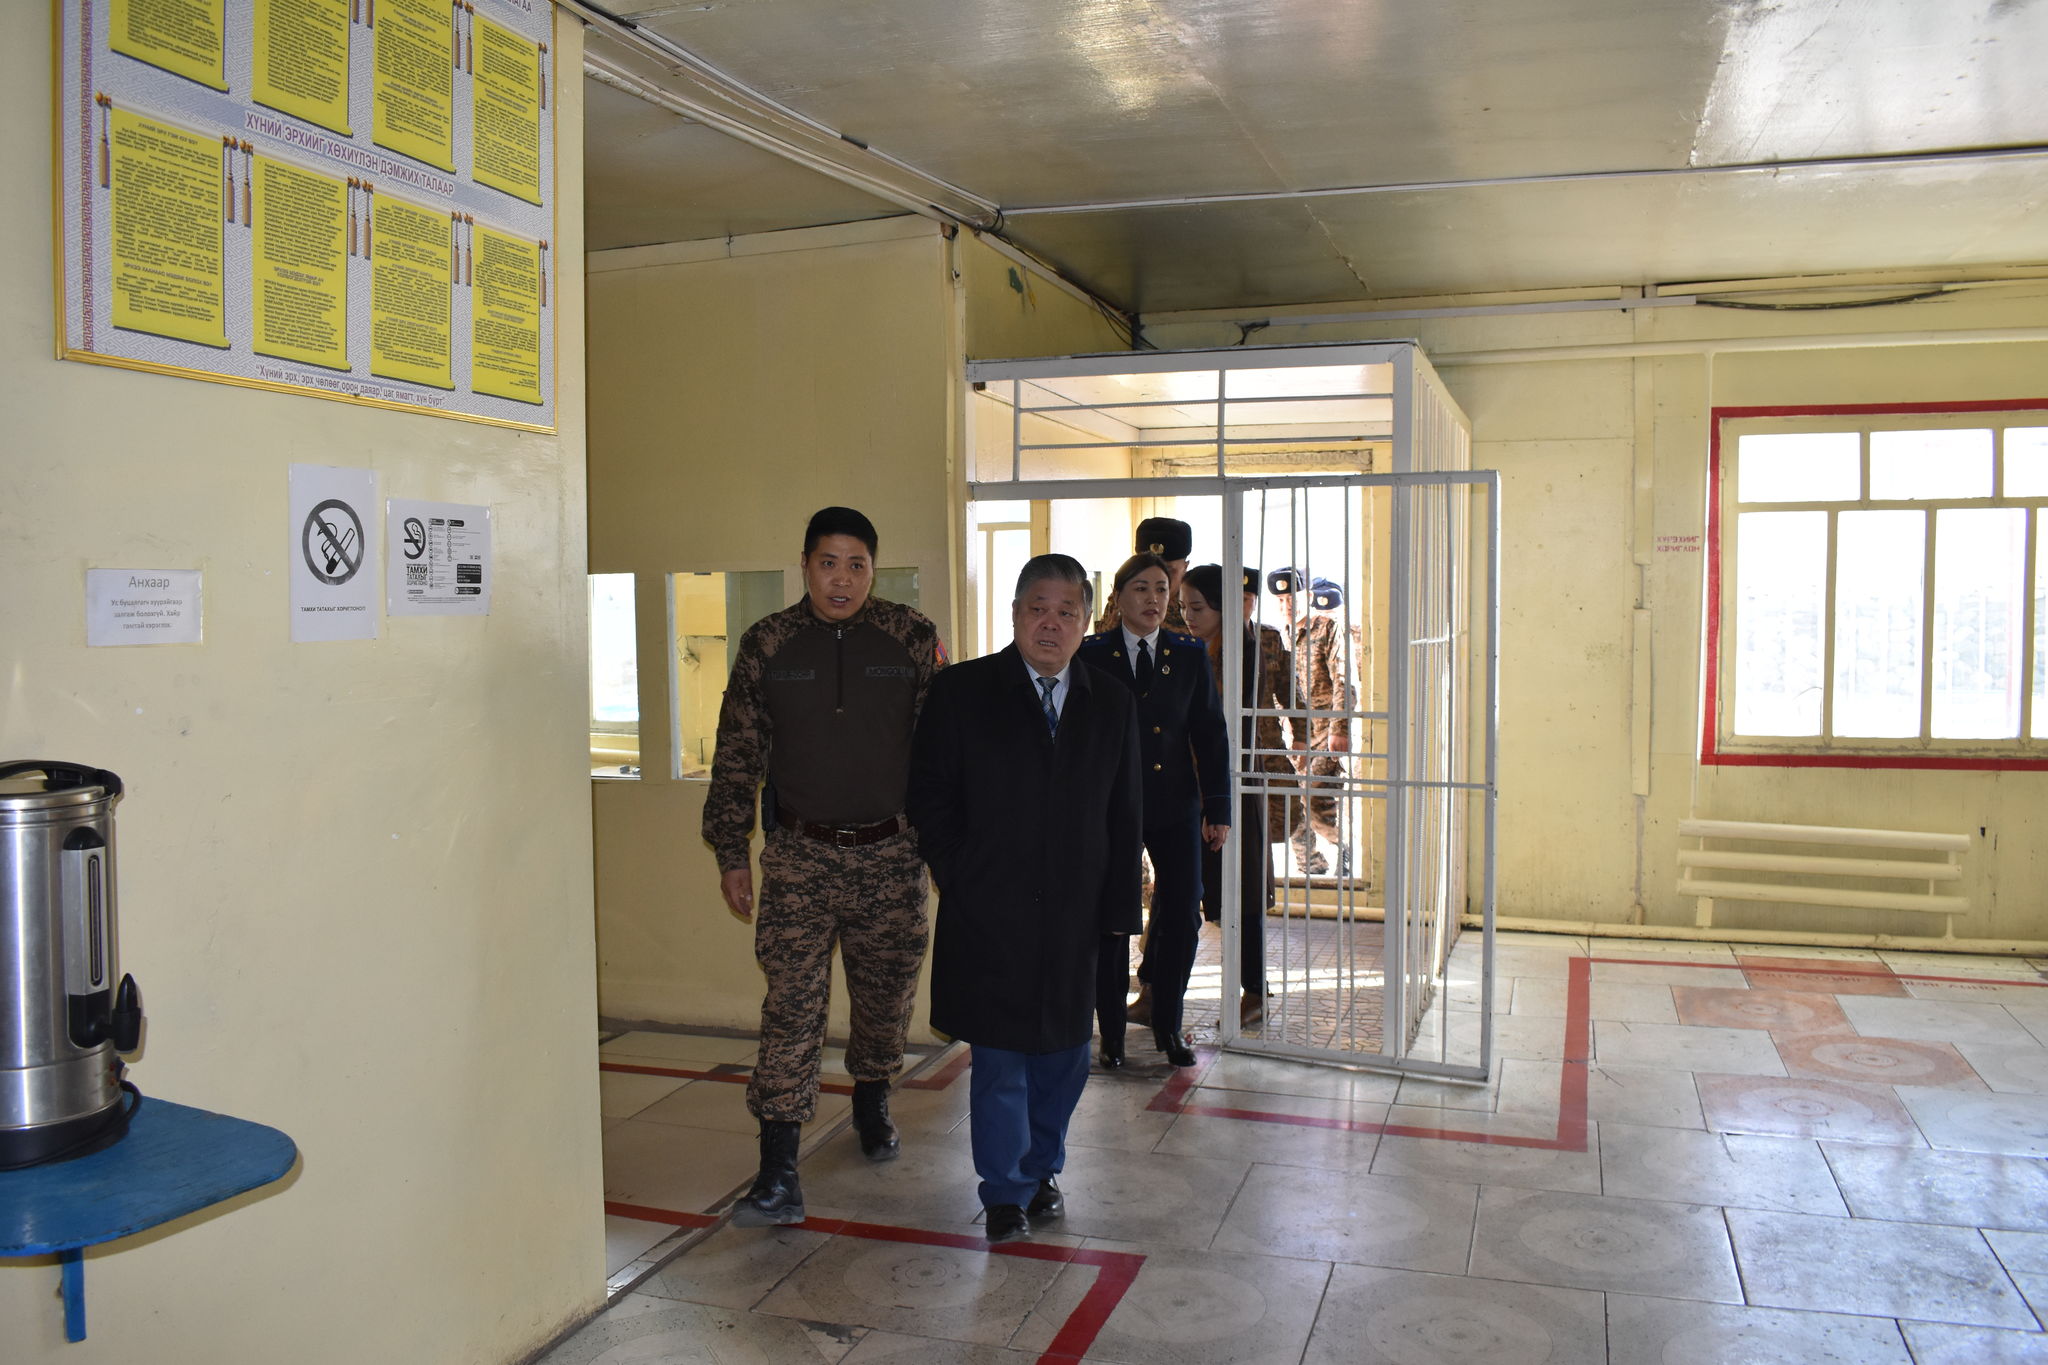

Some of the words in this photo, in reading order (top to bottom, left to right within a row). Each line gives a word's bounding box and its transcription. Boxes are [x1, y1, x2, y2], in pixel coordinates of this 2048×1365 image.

[247, 113, 281, 138] ХҮНИЙ
[285, 127, 325, 152] ЭРХИЙГ
[327, 141, 378, 170] ХӨХИҮЛЭН
[381, 160, 420, 185] ДЭМЖИХ
[421, 174, 454, 196] ТАЛААР
[301, 374, 314, 387] эрх
[341, 382, 359, 394] орон
[128, 576, 170, 590] Анхаар
